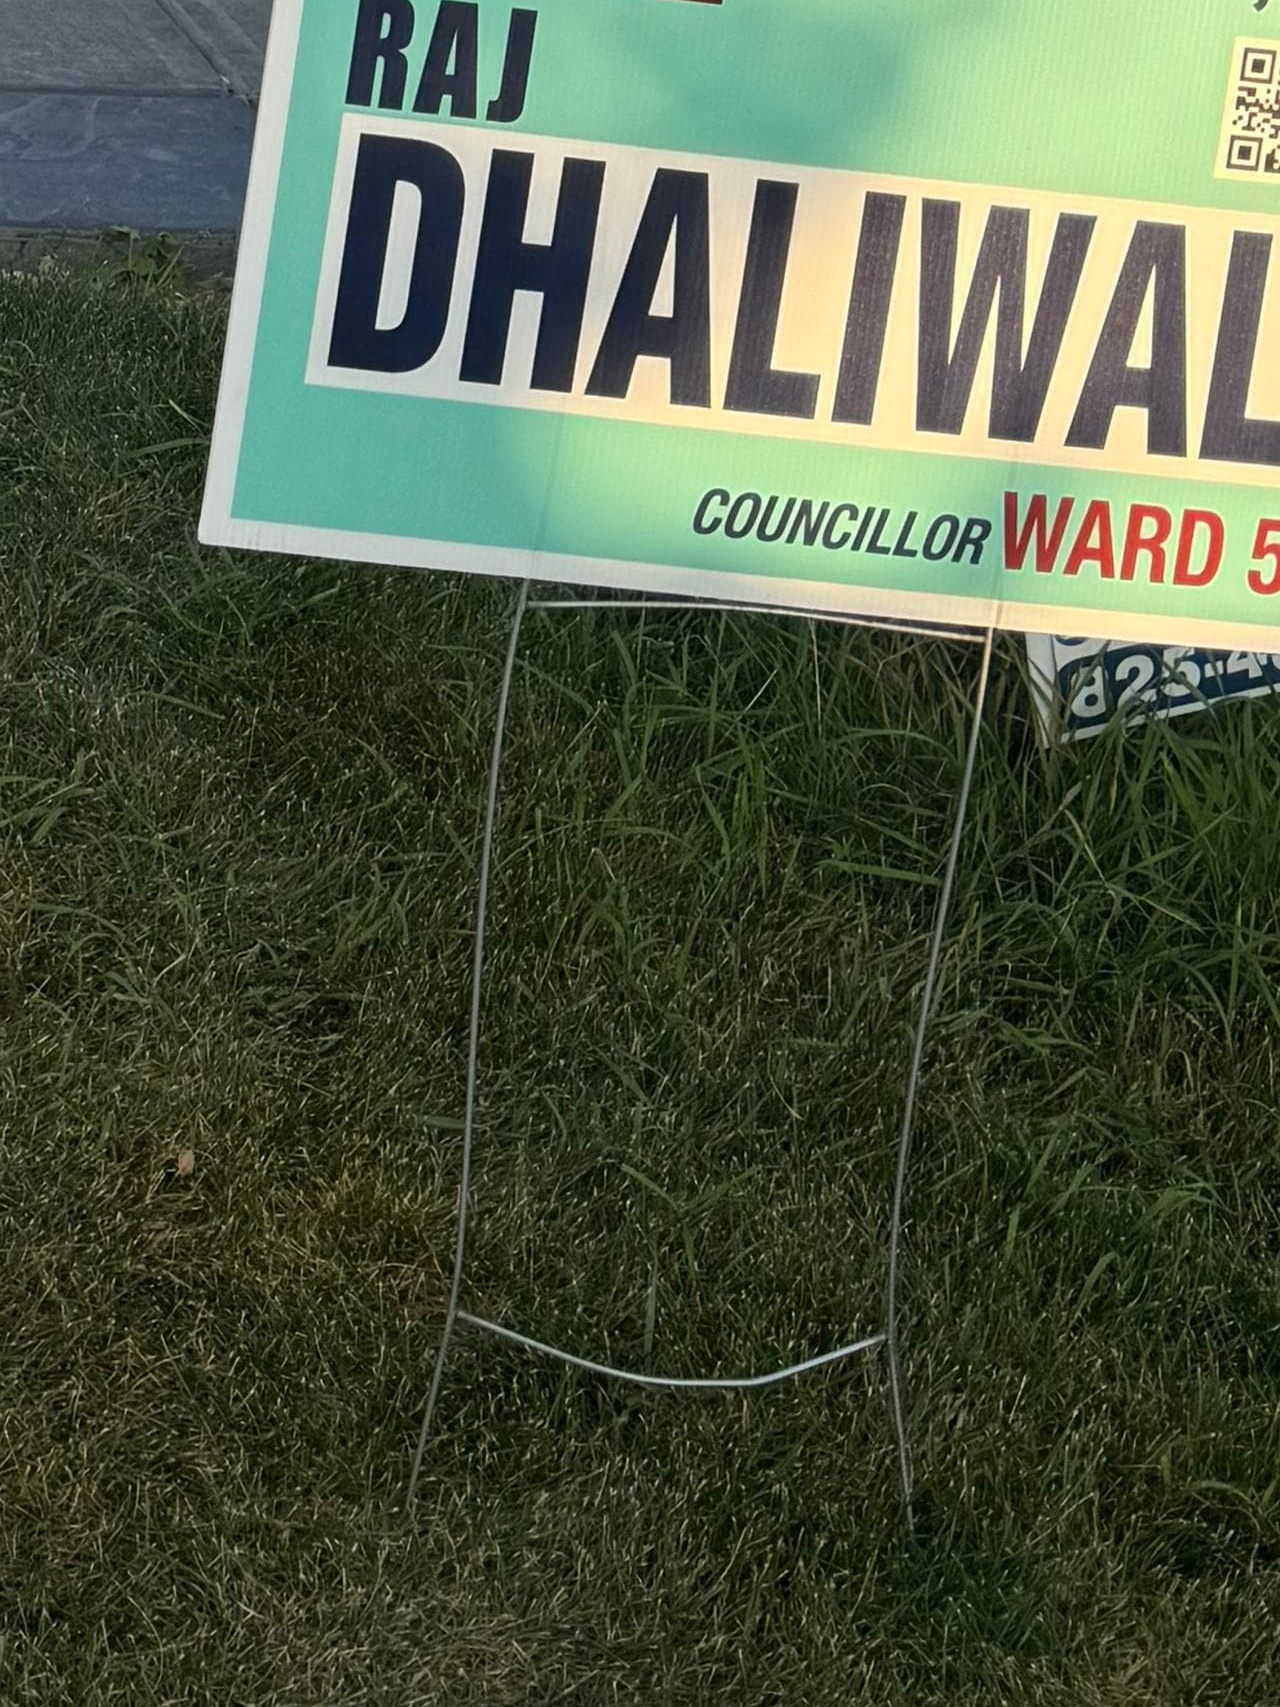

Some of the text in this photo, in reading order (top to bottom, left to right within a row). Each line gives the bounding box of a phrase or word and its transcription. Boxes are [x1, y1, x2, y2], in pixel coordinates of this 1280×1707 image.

[327, 134, 1280, 467] DHALIWAL
[693, 488, 1280, 596] COUNCILLOR WARD 5
[1071, 646, 1280, 718] 825-4
